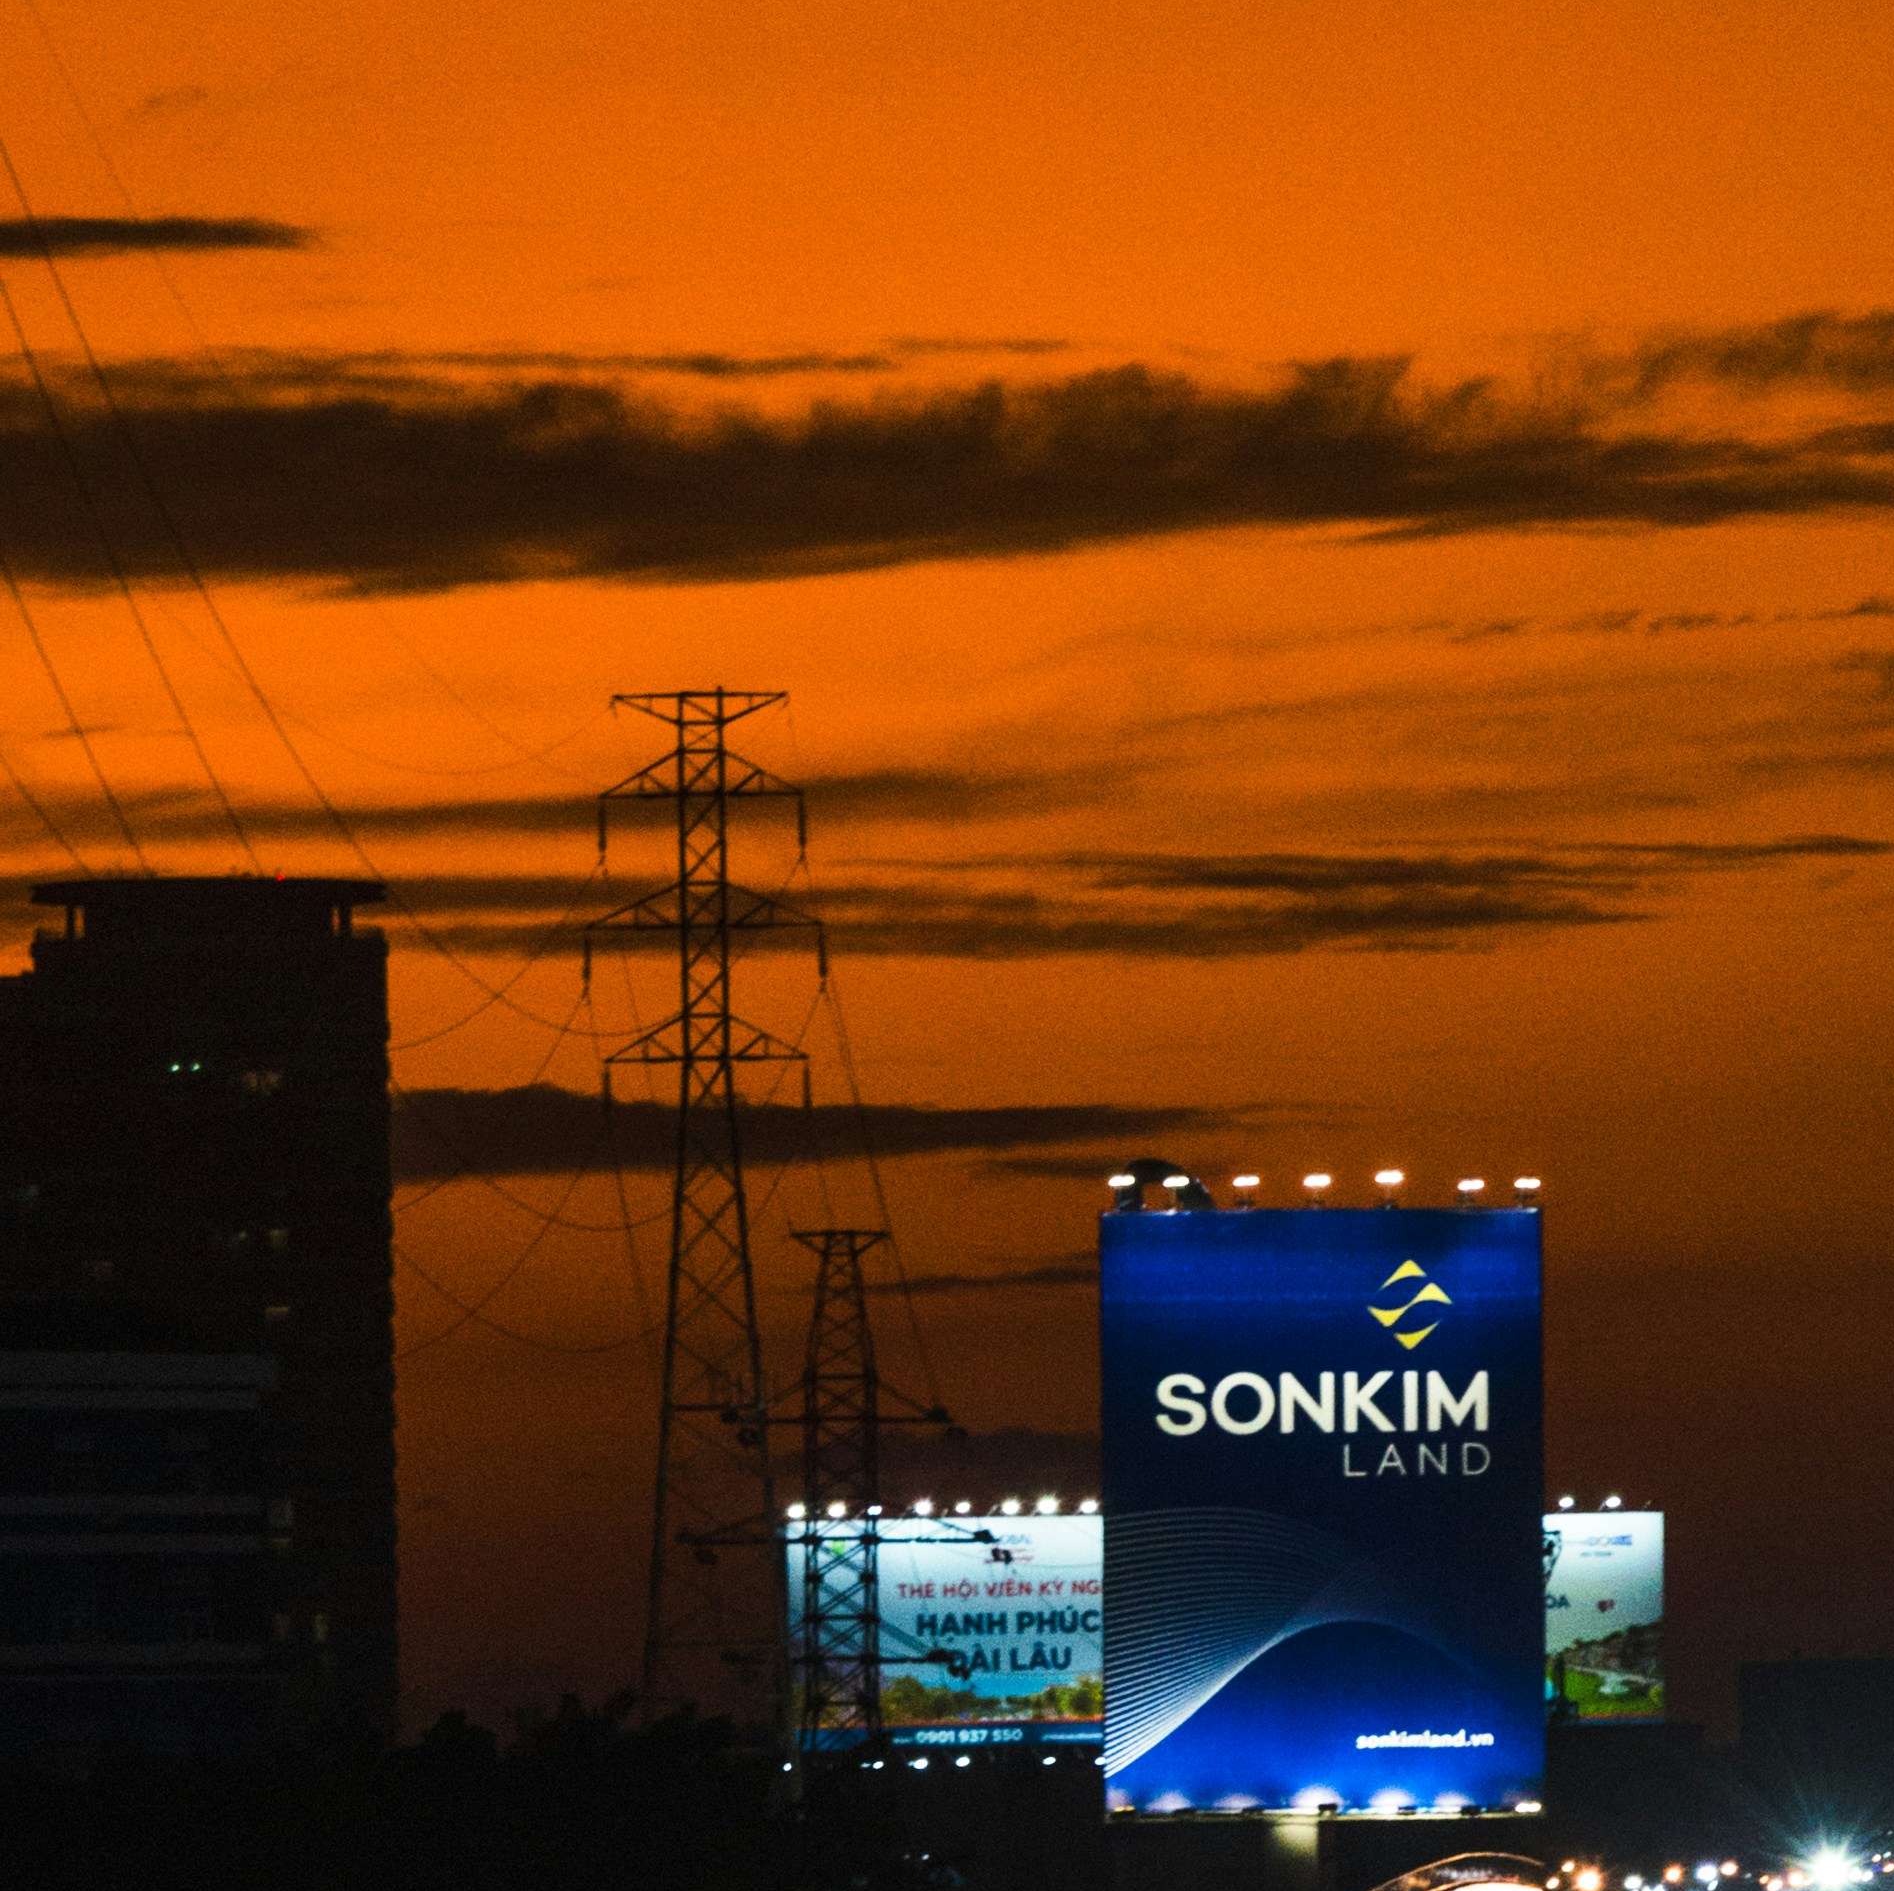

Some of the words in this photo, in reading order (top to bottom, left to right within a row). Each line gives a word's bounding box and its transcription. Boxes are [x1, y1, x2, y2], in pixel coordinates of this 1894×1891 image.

[1155, 1370, 1489, 1436] SONKIM
[1343, 1442, 1491, 1478] LAND
[916, 1611, 1008, 1643] HẠNH
[1015, 1605, 1101, 1635] PHÚC
[1009, 1640, 1072, 1672] LÂU
[1356, 1728, 1495, 1749] sonkimland.vn
